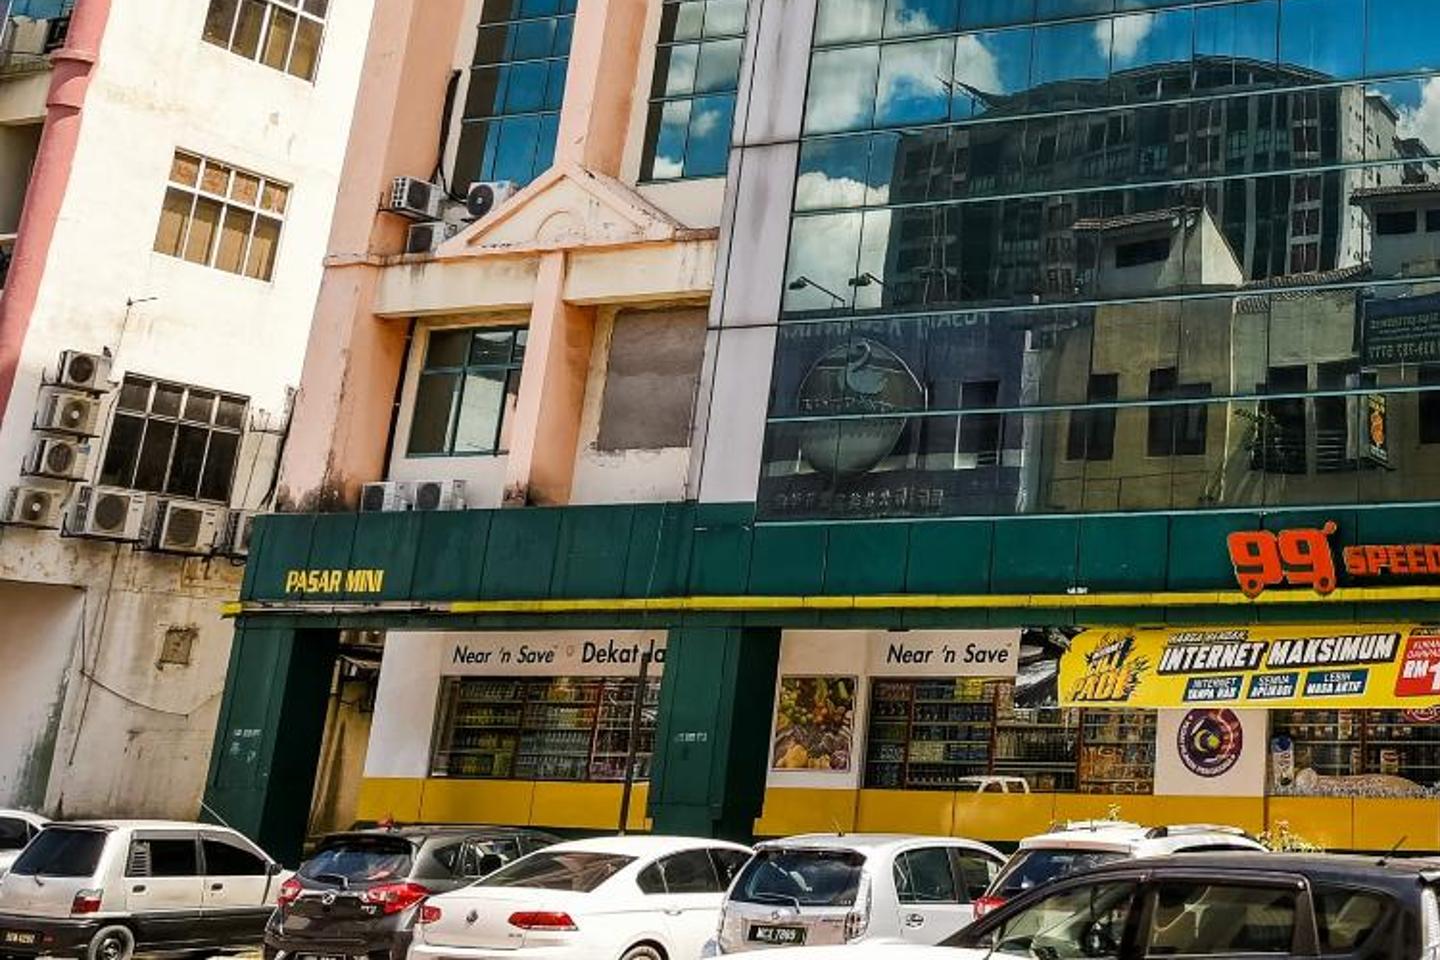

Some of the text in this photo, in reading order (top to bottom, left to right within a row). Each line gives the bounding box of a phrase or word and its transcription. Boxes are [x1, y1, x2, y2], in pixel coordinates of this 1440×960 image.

[1226, 520, 1337, 599] 99
[285, 570, 384, 593] PASAR MINI
[453, 644, 492, 664] Near
[516, 644, 555, 663] Save
[581, 639, 639, 663] Dekat
[886, 643, 934, 664] Near
[963, 643, 1009, 663] Save
[1160, 642, 1266, 672] INTERNET
[1267, 634, 1396, 666] MAKSIMUM
